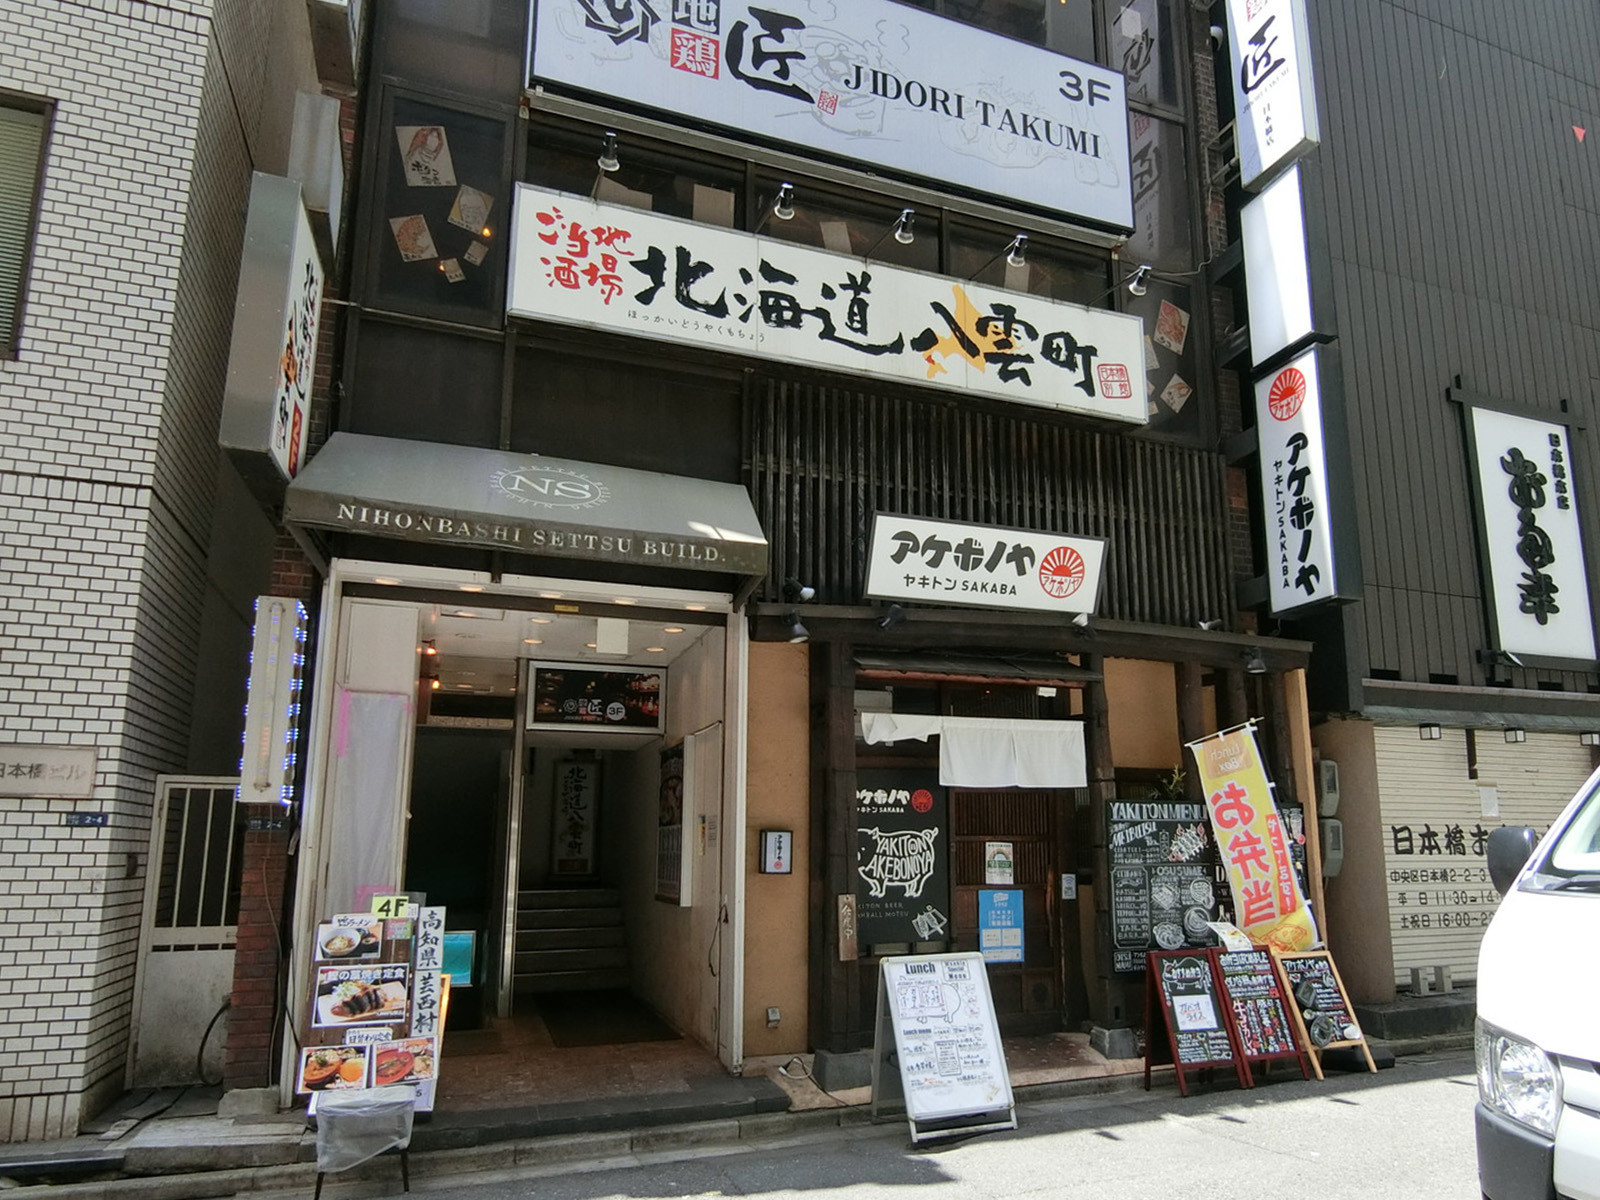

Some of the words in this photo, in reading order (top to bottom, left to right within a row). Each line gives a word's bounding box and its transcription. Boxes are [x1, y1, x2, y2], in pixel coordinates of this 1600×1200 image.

[725, 6, 815, 104] 匠
[1059, 69, 1111, 107] 3F
[844, 61, 965, 121] JIDORI
[976, 97, 1102, 159] TAKUMI
[540, 253, 624, 305] 酒場
[511, 471, 593, 501] NS
[336, 503, 522, 543] NIHONBASHI
[532, 528, 635, 555] SETTSU
[642, 541, 728, 563] BUILD.
[1285, 431, 1321, 596] アケボノヤ
[889, 530, 1036, 577] アケボノヤ
[903, 573, 958, 591] ヤキトン
[961, 579, 1018, 596] SAKABA
[608, 706, 623, 716] 3F
[857, 789, 911, 805] ケボノヤ
[864, 849, 933, 881] AKEBONOYA
[378, 898, 408, 917] 4F
[418, 909, 443, 967] 高知県
[904, 961, 936, 975] Lunch
[413, 972, 439, 1034] 芸西村
